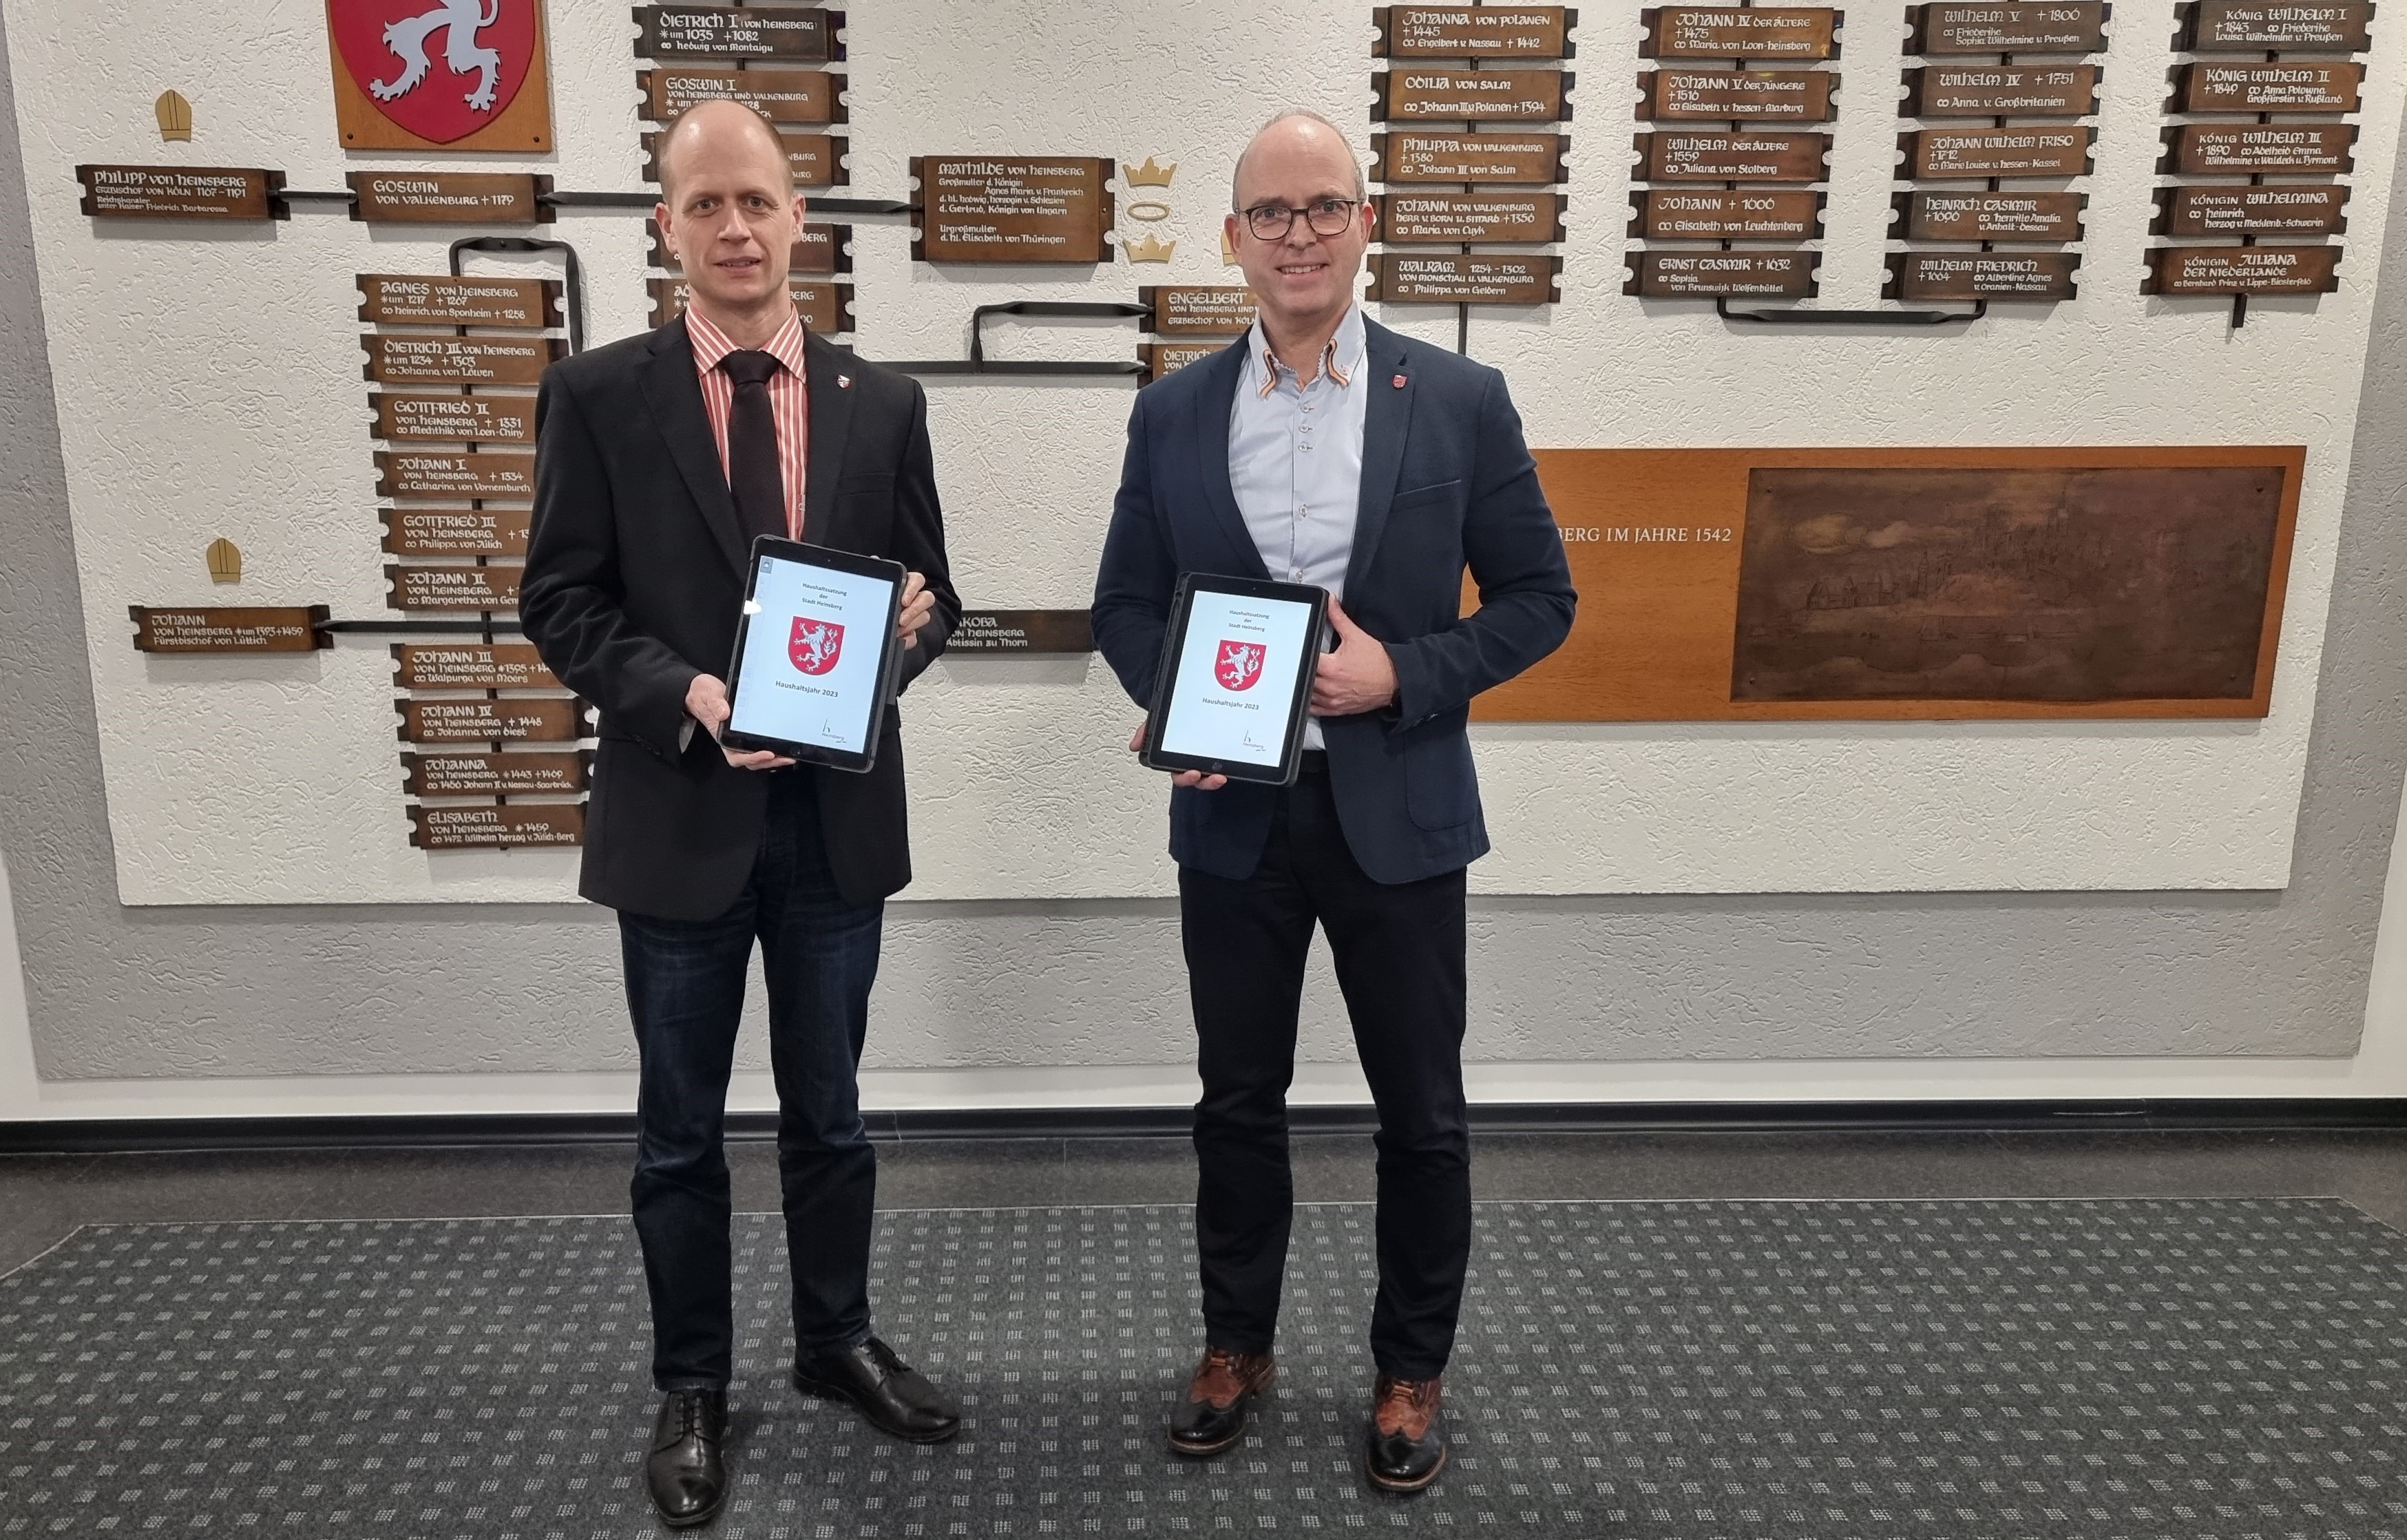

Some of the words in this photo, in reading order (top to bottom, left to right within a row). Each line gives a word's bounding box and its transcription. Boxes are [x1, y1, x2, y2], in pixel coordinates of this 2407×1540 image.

[1418, 39, 1458, 48] Engelbert
[1469, 39, 1502, 48] Nassau
[1951, 97, 1979, 107] Anna
[1418, 165, 1454, 175] Johann
[1458, 165, 1468, 174] III
[1490, 165, 1515, 174] Salm
[939, 178, 985, 187] Großmutter
[995, 178, 1023, 187] Königin
[985, 187, 1008, 196] Agnes
[1044, 188, 1084, 196] Frankreich
[939, 224, 997, 233] Urgroßmutter
[1674, 220, 1721, 231] Elisabeth
[1670, 274, 1699, 284] Sophia
[1414, 285, 1452, 295] Philippa
[449, 308, 491, 318] Sponheim
[398, 367, 439, 376] Johanna
[1607, 528, 1629, 542] IM
[1635, 528, 1688, 544] JAHRE
[1695, 529, 1731, 542] 1542
[419, 540, 456, 549] Philippa
[802, 582, 847, 597] Haushaltssatzung
[817, 600, 843, 611] Heinsberg
[1229, 609, 1269, 620] Haushaltssatzung
[999, 637, 1027, 646] Thorn
[775, 680, 821, 696] Haushaltsjahr
[822, 689, 838, 697] 2023
[1202, 697, 1243, 709] Haushaltsjahr
